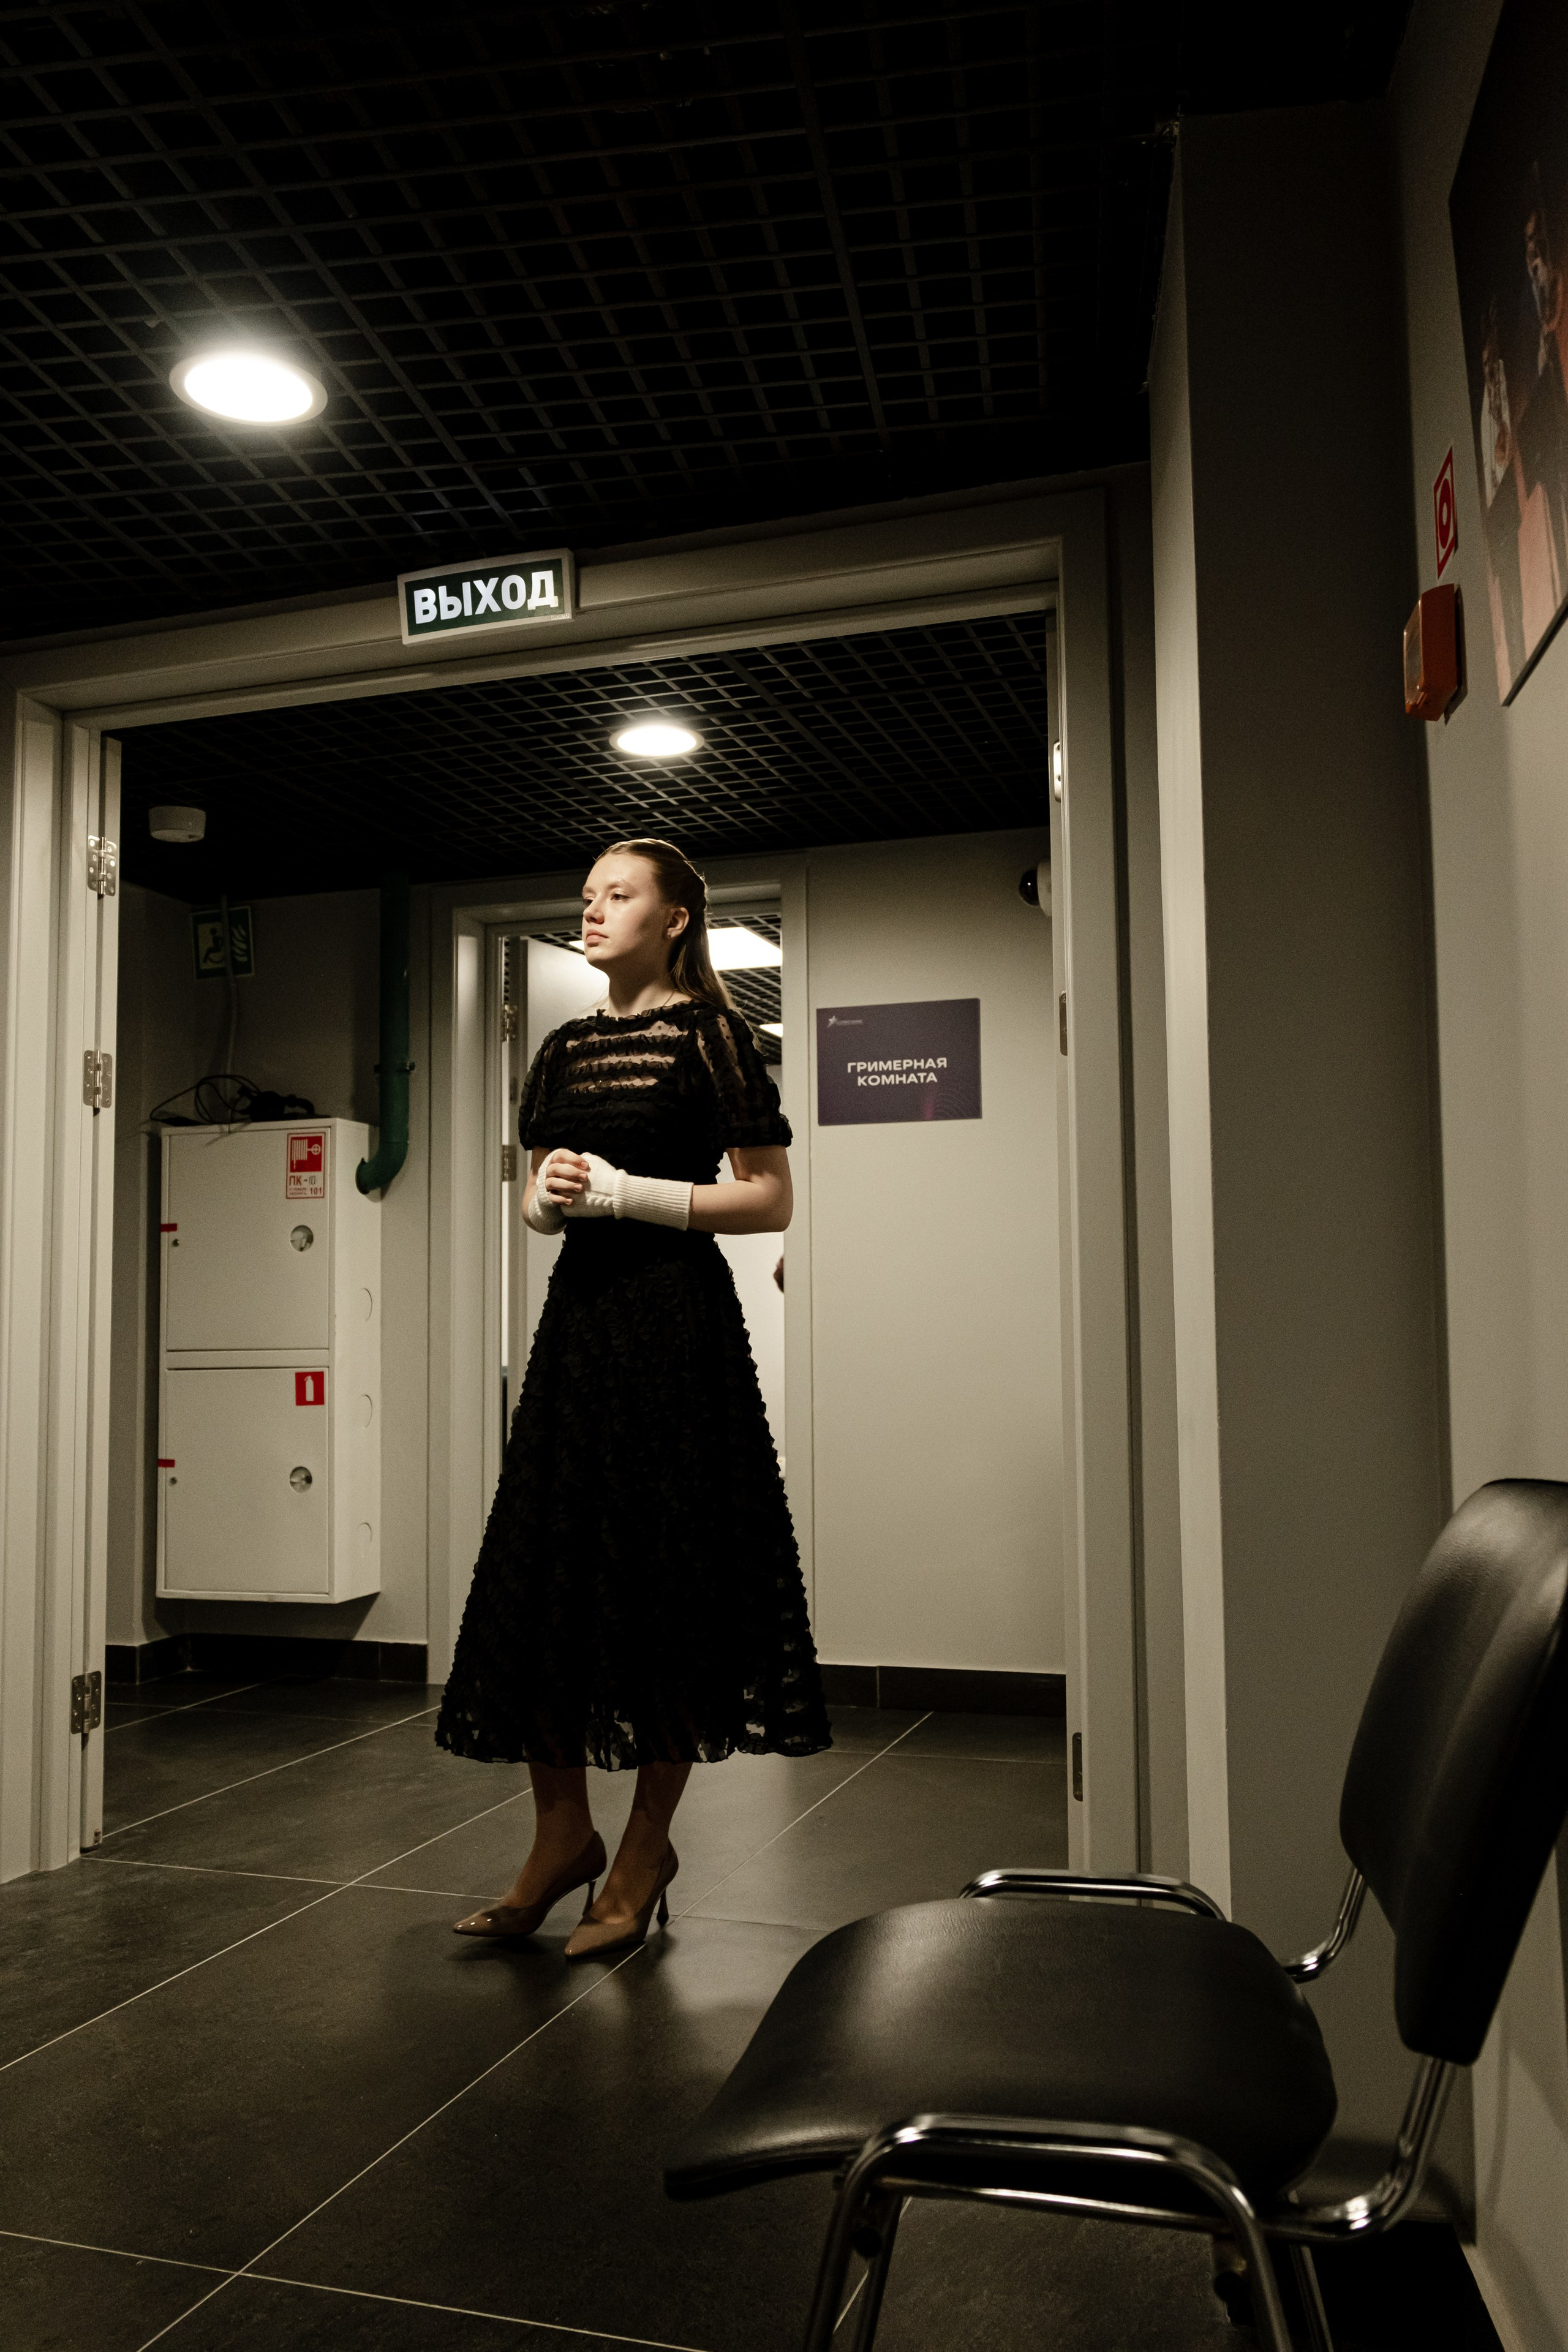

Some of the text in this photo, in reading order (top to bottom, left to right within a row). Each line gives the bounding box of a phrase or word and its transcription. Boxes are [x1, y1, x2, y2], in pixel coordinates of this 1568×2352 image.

[413, 570, 558, 624] ВЫХОД
[848, 1057, 947, 1072] ГРИМЕРНАЯ
[858, 1072, 938, 1086] КОМНАТА
